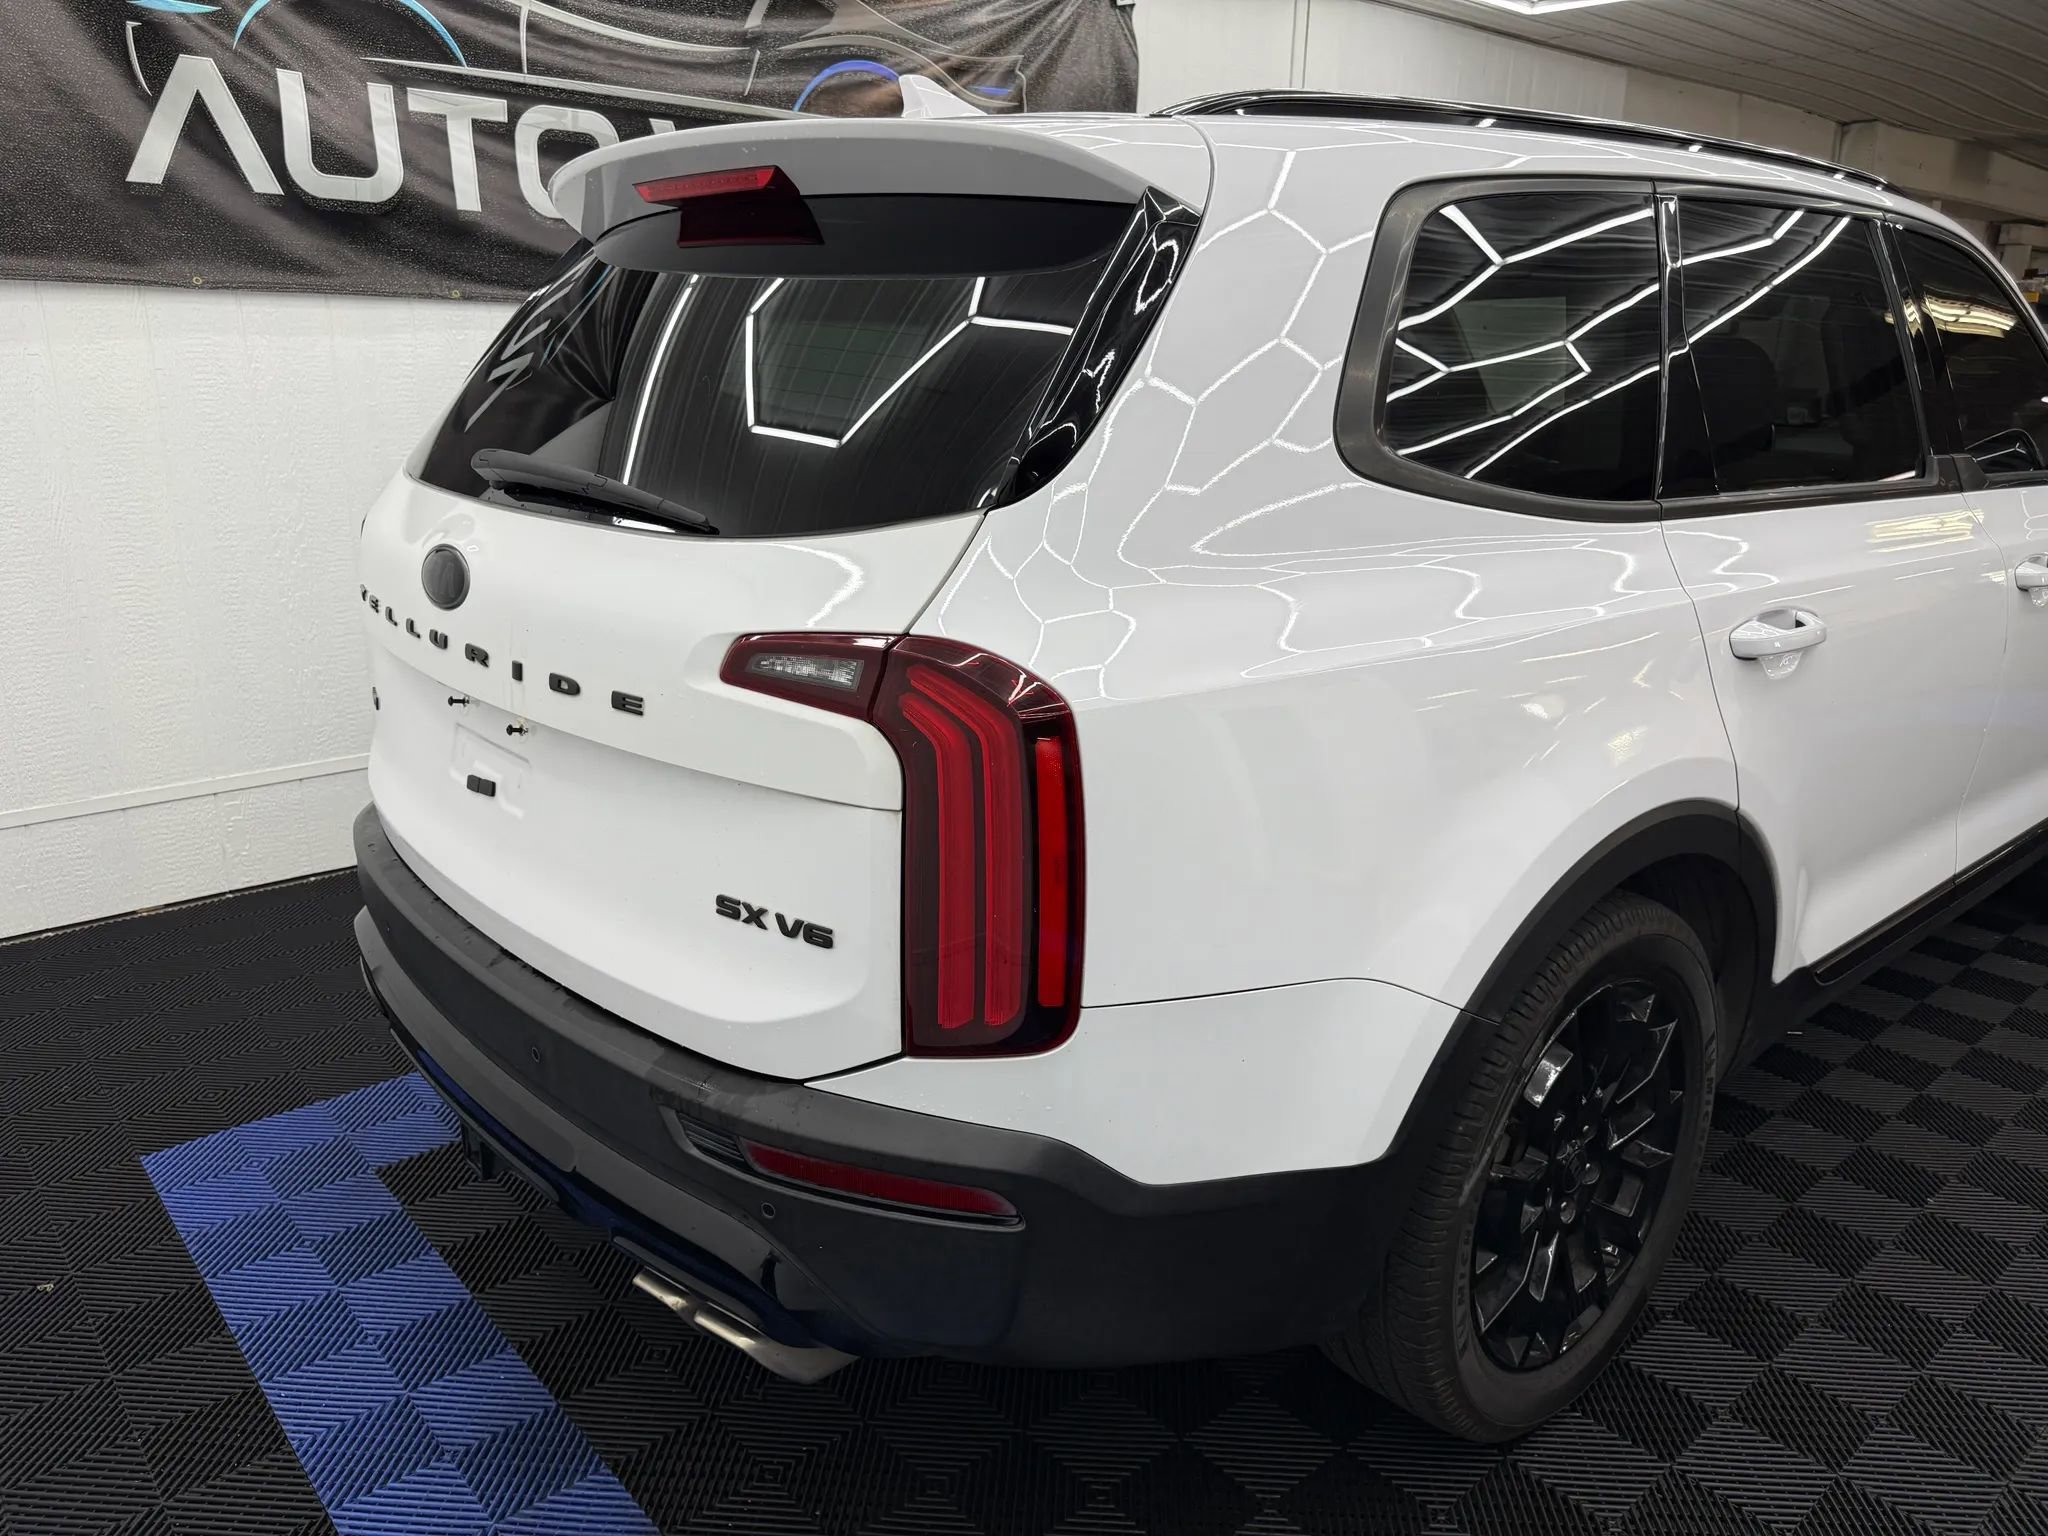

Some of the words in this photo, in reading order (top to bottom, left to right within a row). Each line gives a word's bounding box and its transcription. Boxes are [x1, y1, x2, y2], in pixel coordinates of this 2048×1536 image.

[125, 54, 676, 219] AUTO
[715, 894, 768, 931] SX
[775, 912, 834, 949] V6
